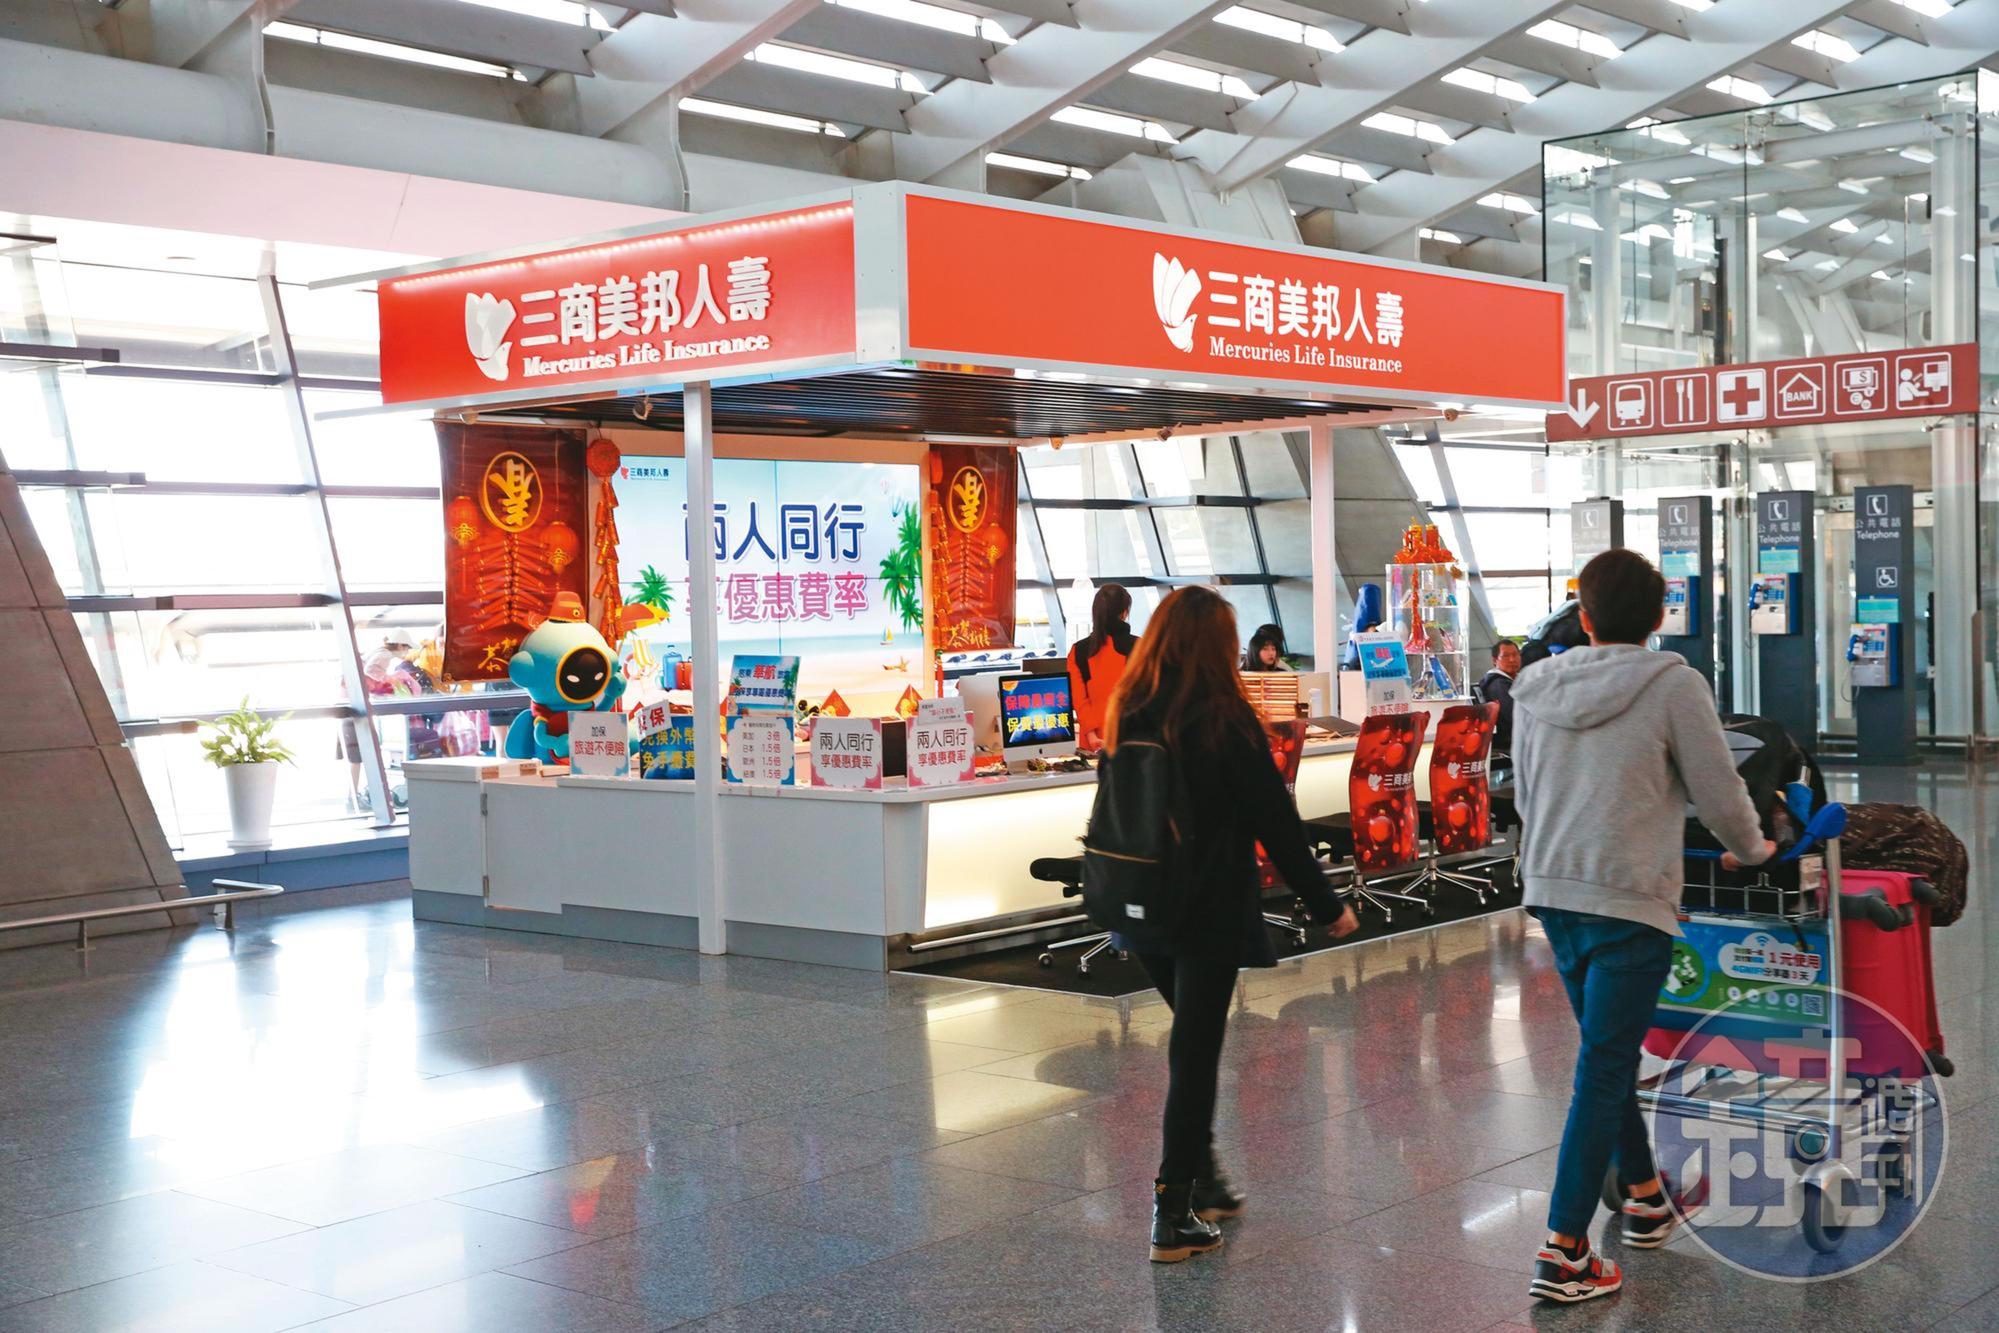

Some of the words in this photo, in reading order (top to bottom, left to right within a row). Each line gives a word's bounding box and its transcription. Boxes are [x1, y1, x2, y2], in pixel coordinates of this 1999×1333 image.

[520, 256, 771, 346] 三商美邦人壽
[1207, 271, 1404, 348] 三商美邦人壽
[523, 350, 617, 378] Mercuries
[618, 343, 662, 367] Life
[663, 333, 771, 362] Insurance
[1209, 336, 1290, 363] Mercuries
[1294, 344, 1325, 366] Life
[1329, 348, 1402, 373] Insurance
[1787, 391, 1813, 402] BANK
[1855, 516, 1901, 529] 公共電話
[1759, 535, 1799, 544] Telephone
[1856, 530, 1899, 540] Telephone
[684, 571, 868, 620] 優惠費率
[819, 732, 874, 752] 兩人同行
[917, 728, 967, 750] 兩人同行
[821, 754, 873, 769] 享優惠費率
[918, 750, 966, 767] 享優惠費率
